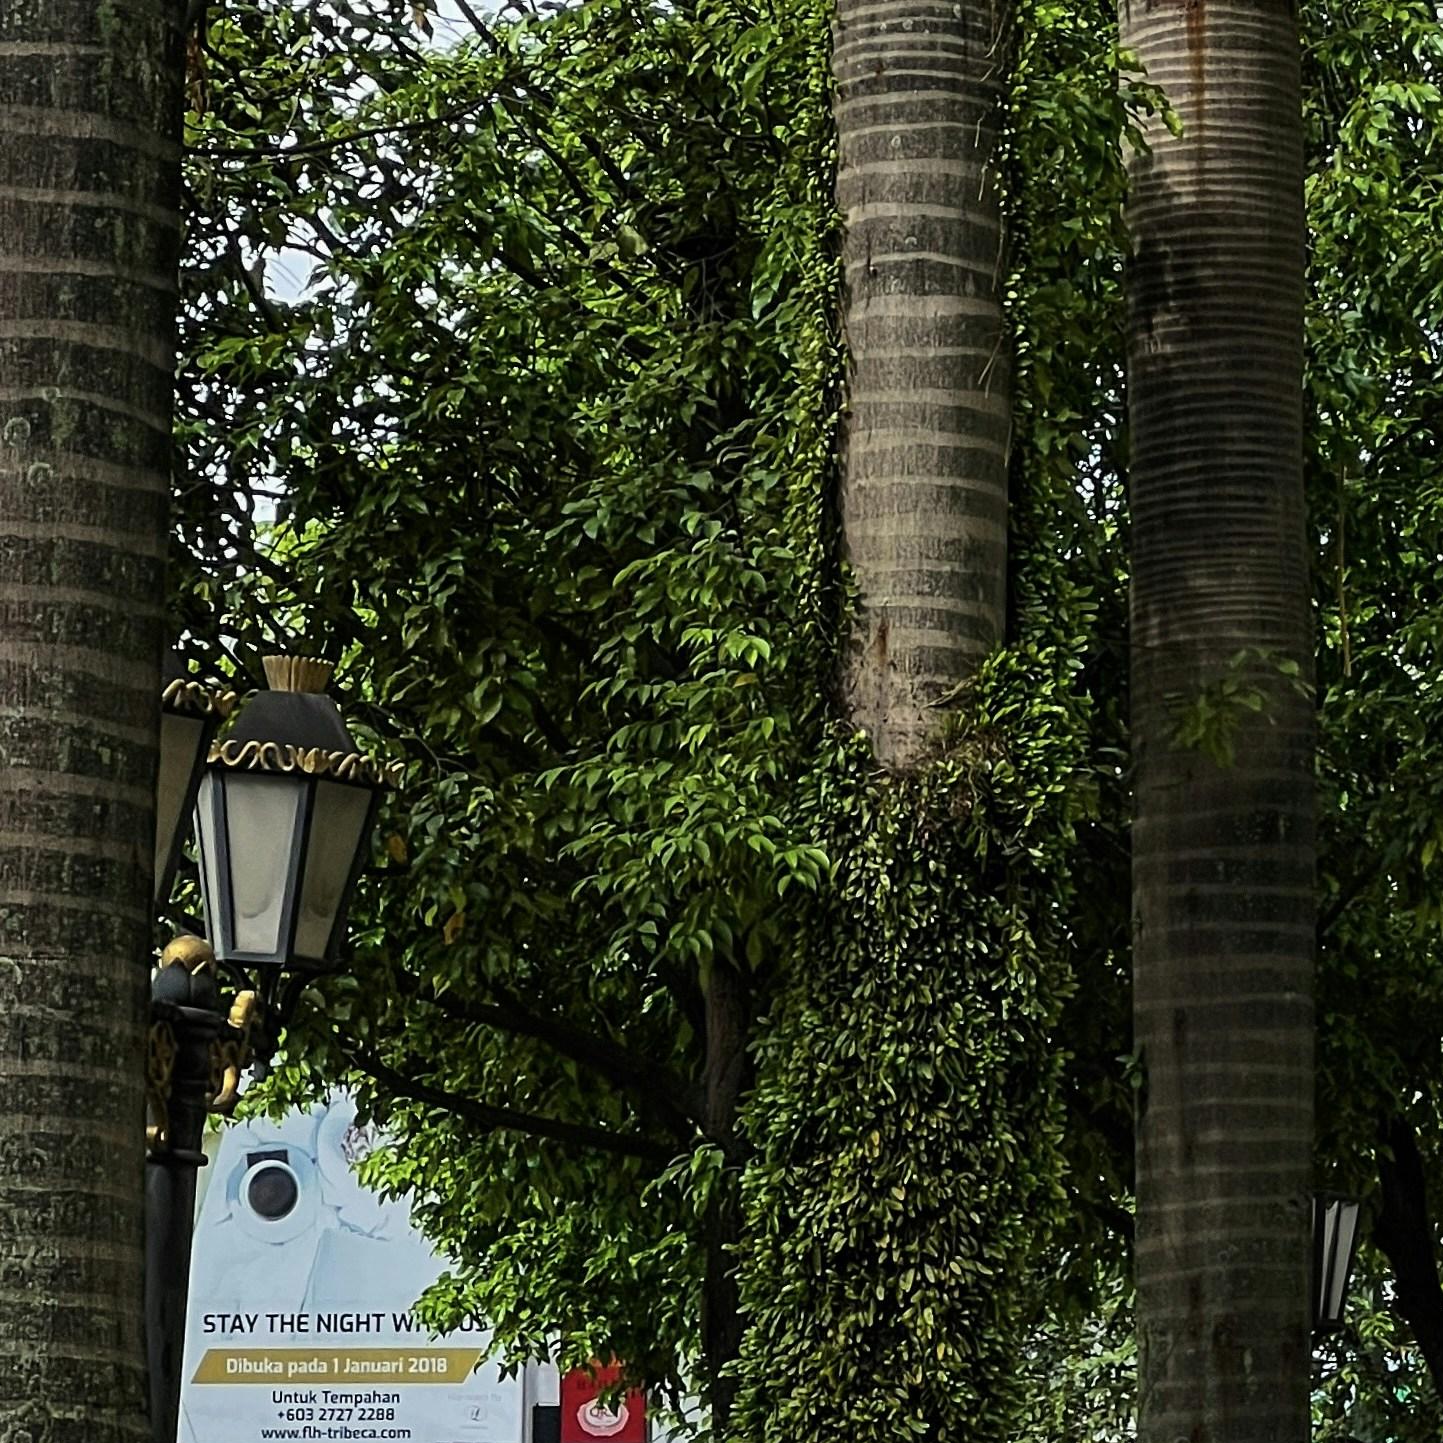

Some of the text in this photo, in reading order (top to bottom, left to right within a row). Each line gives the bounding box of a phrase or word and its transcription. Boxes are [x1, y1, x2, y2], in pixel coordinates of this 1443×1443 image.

[203, 1313, 258, 1333] STAY
[266, 1313, 309, 1333] THE
[317, 1313, 385, 1333] NIGHT
[226, 1357, 448, 1378] Dibuka pada 1 Januari 2018
[272, 1390, 400, 1407] Untuk Tempahan
[278, 1408, 395, 1421] +603 2727 2288
[261, 1426, 411, 1439] www.flh-tribeca.com
